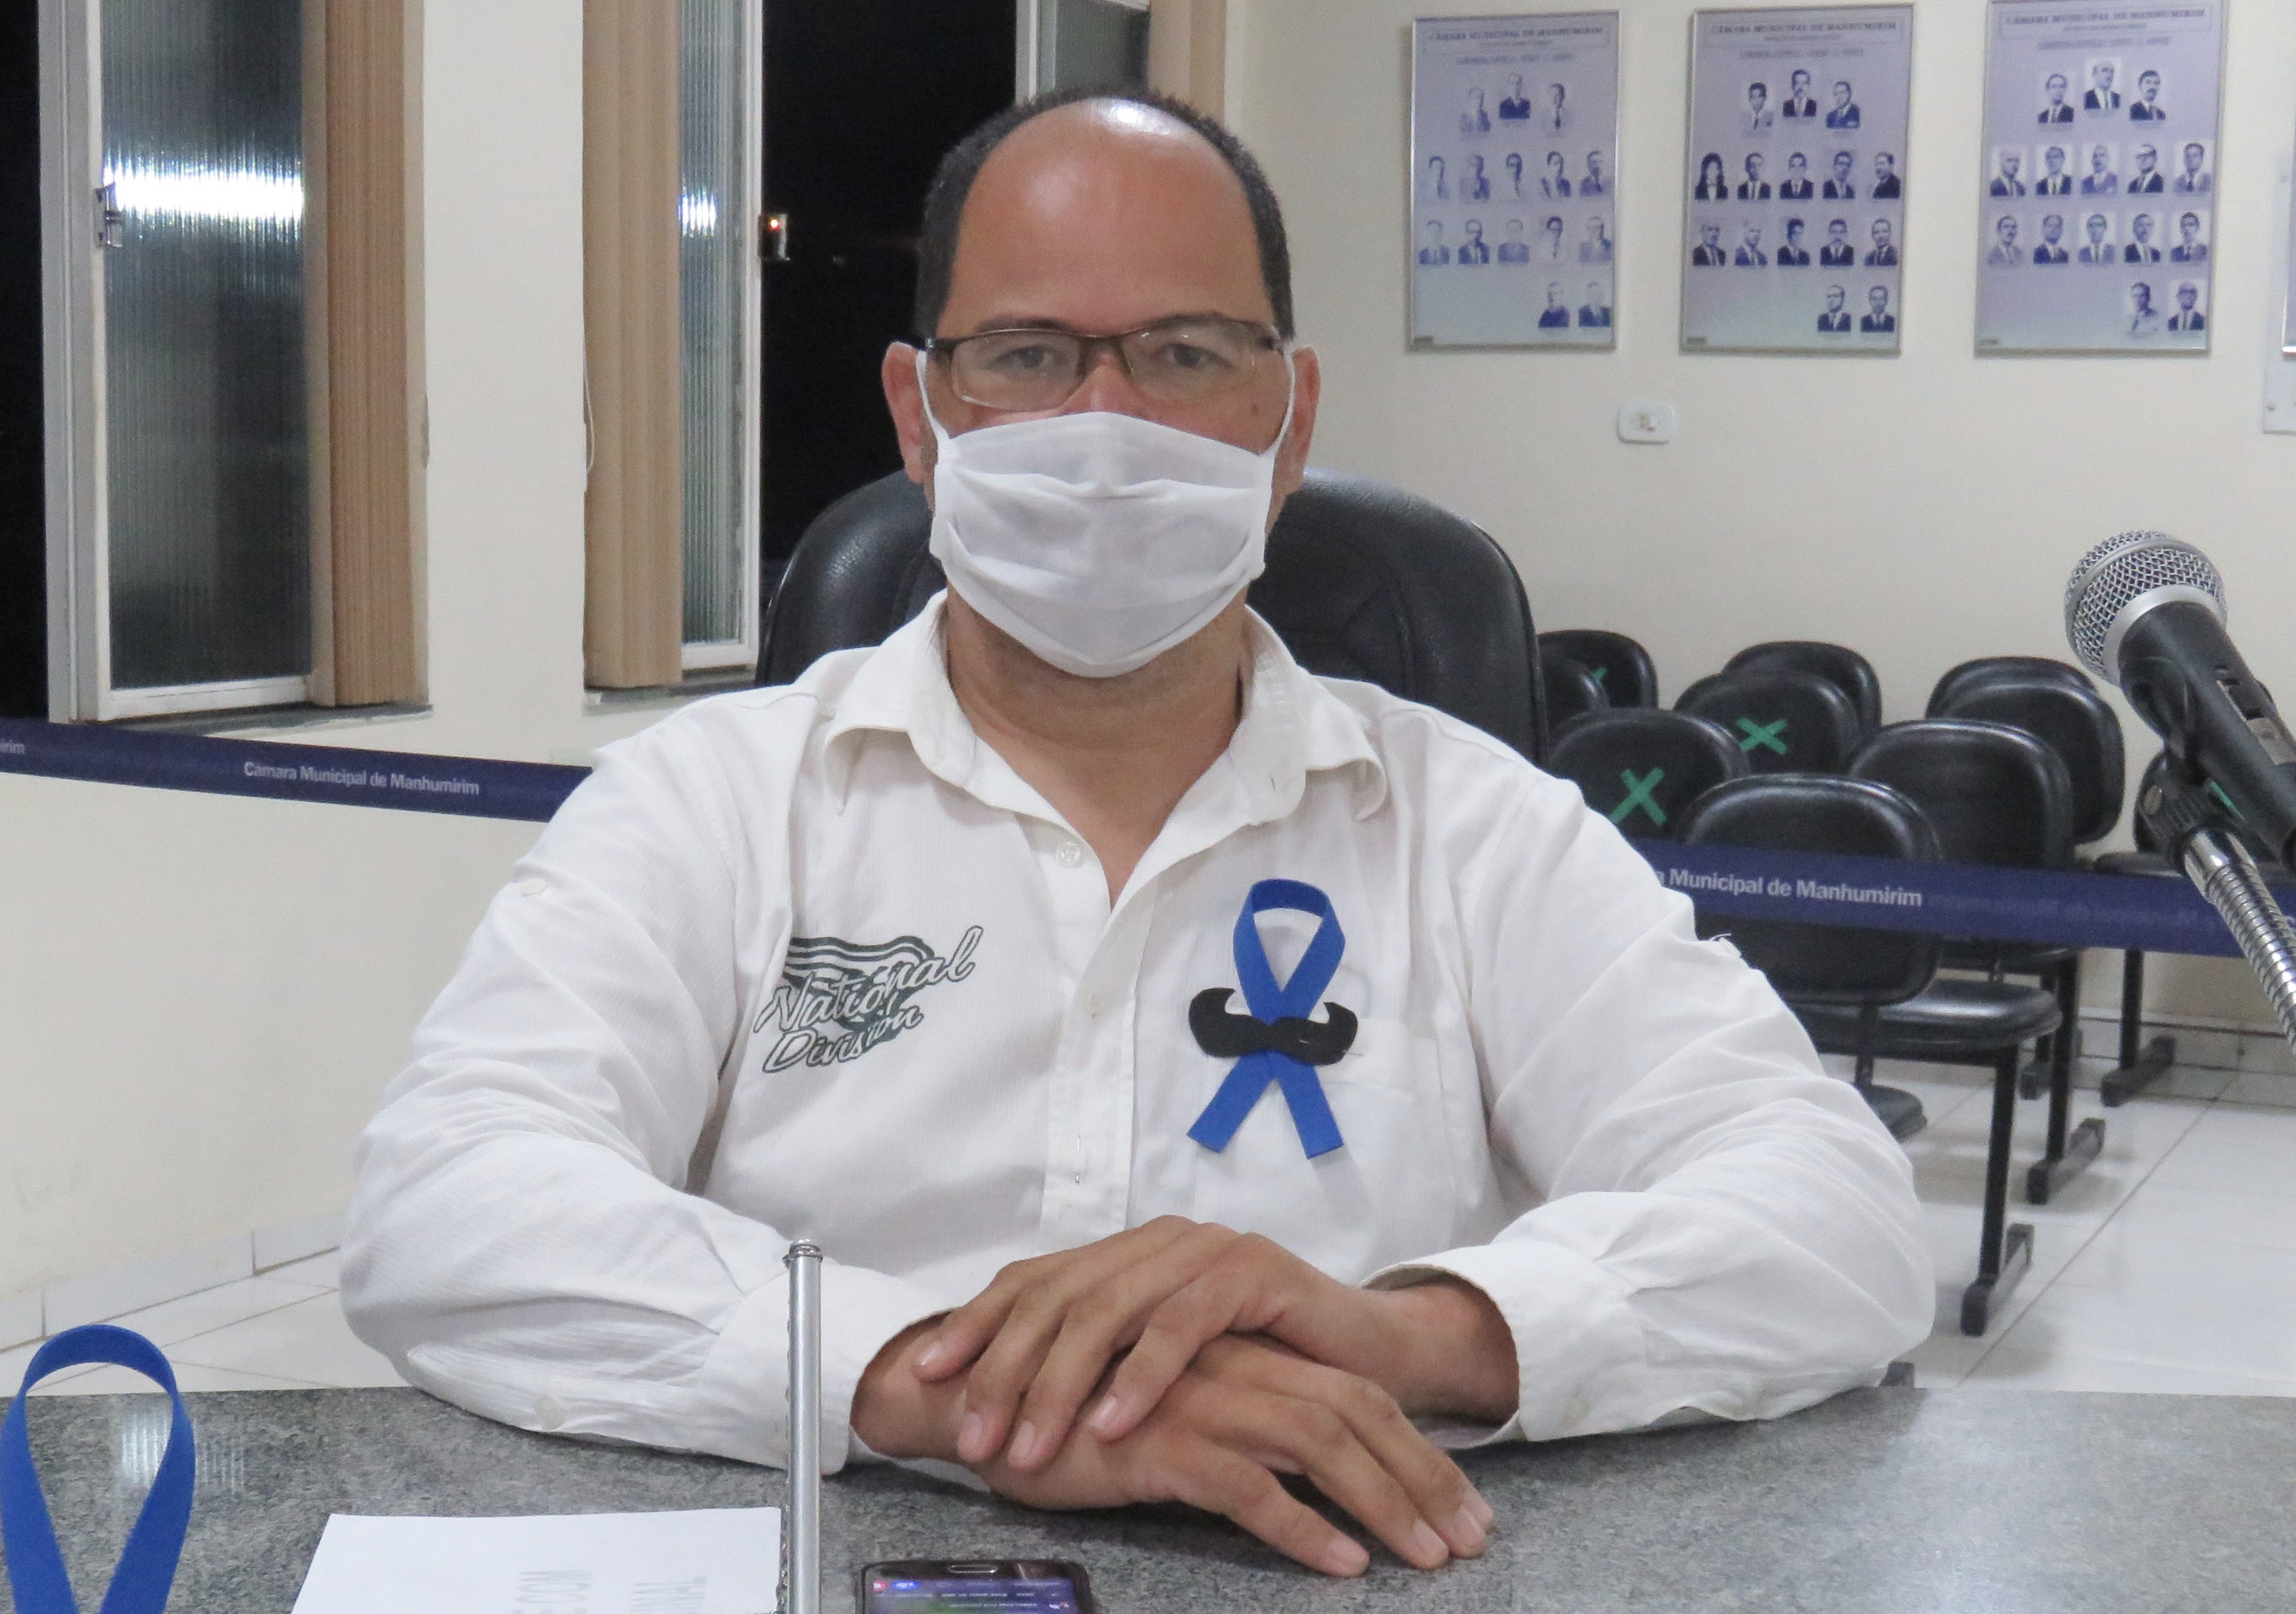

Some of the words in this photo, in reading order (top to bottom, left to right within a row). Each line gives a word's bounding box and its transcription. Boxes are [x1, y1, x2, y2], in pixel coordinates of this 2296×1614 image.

[300, 766, 366, 787] Municipal
[370, 771, 387, 787] de
[390, 773, 480, 795] Manhumirim
[1670, 868, 1763, 895] Municipal
[1768, 879, 1792, 896] de
[1796, 880, 1923, 907] Manhumirim
[754, 925, 983, 1033] National
[763, 1004, 924, 1074] Division
